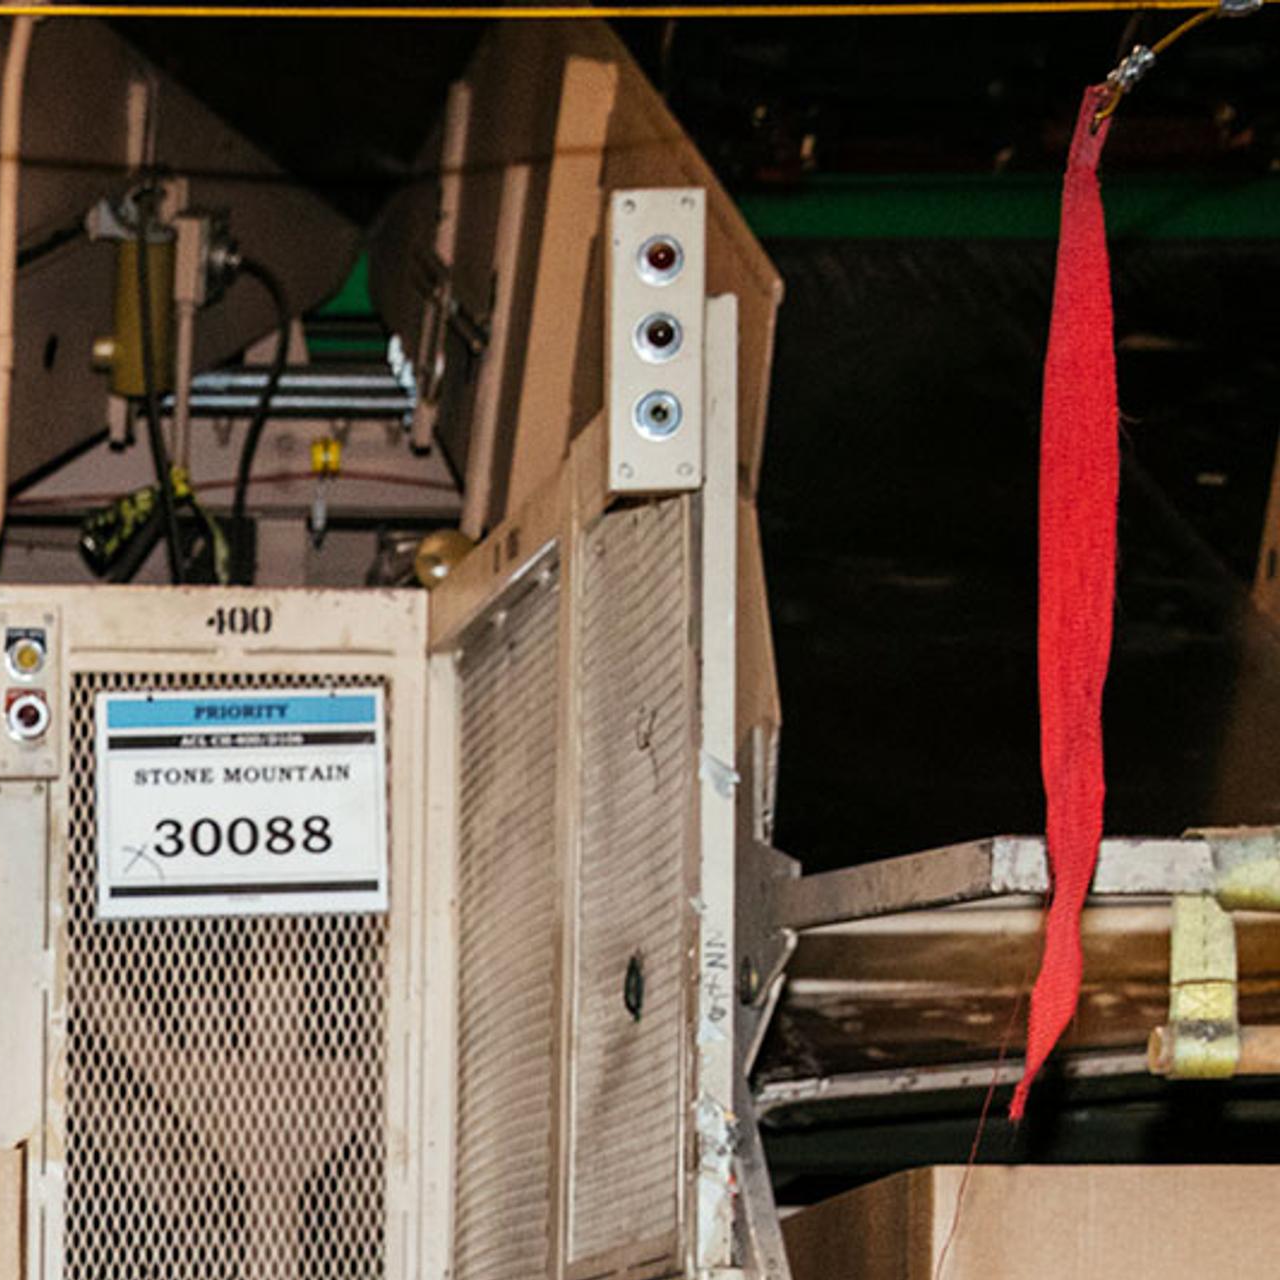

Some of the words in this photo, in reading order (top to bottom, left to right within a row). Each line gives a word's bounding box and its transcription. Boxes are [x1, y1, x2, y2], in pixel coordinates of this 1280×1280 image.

[206, 606, 273, 635] 400
[193, 704, 289, 721] PRIORITY
[134, 767, 214, 786] STONE
[223, 764, 351, 783] MOUNTAIN
[153, 815, 333, 858] 30088
